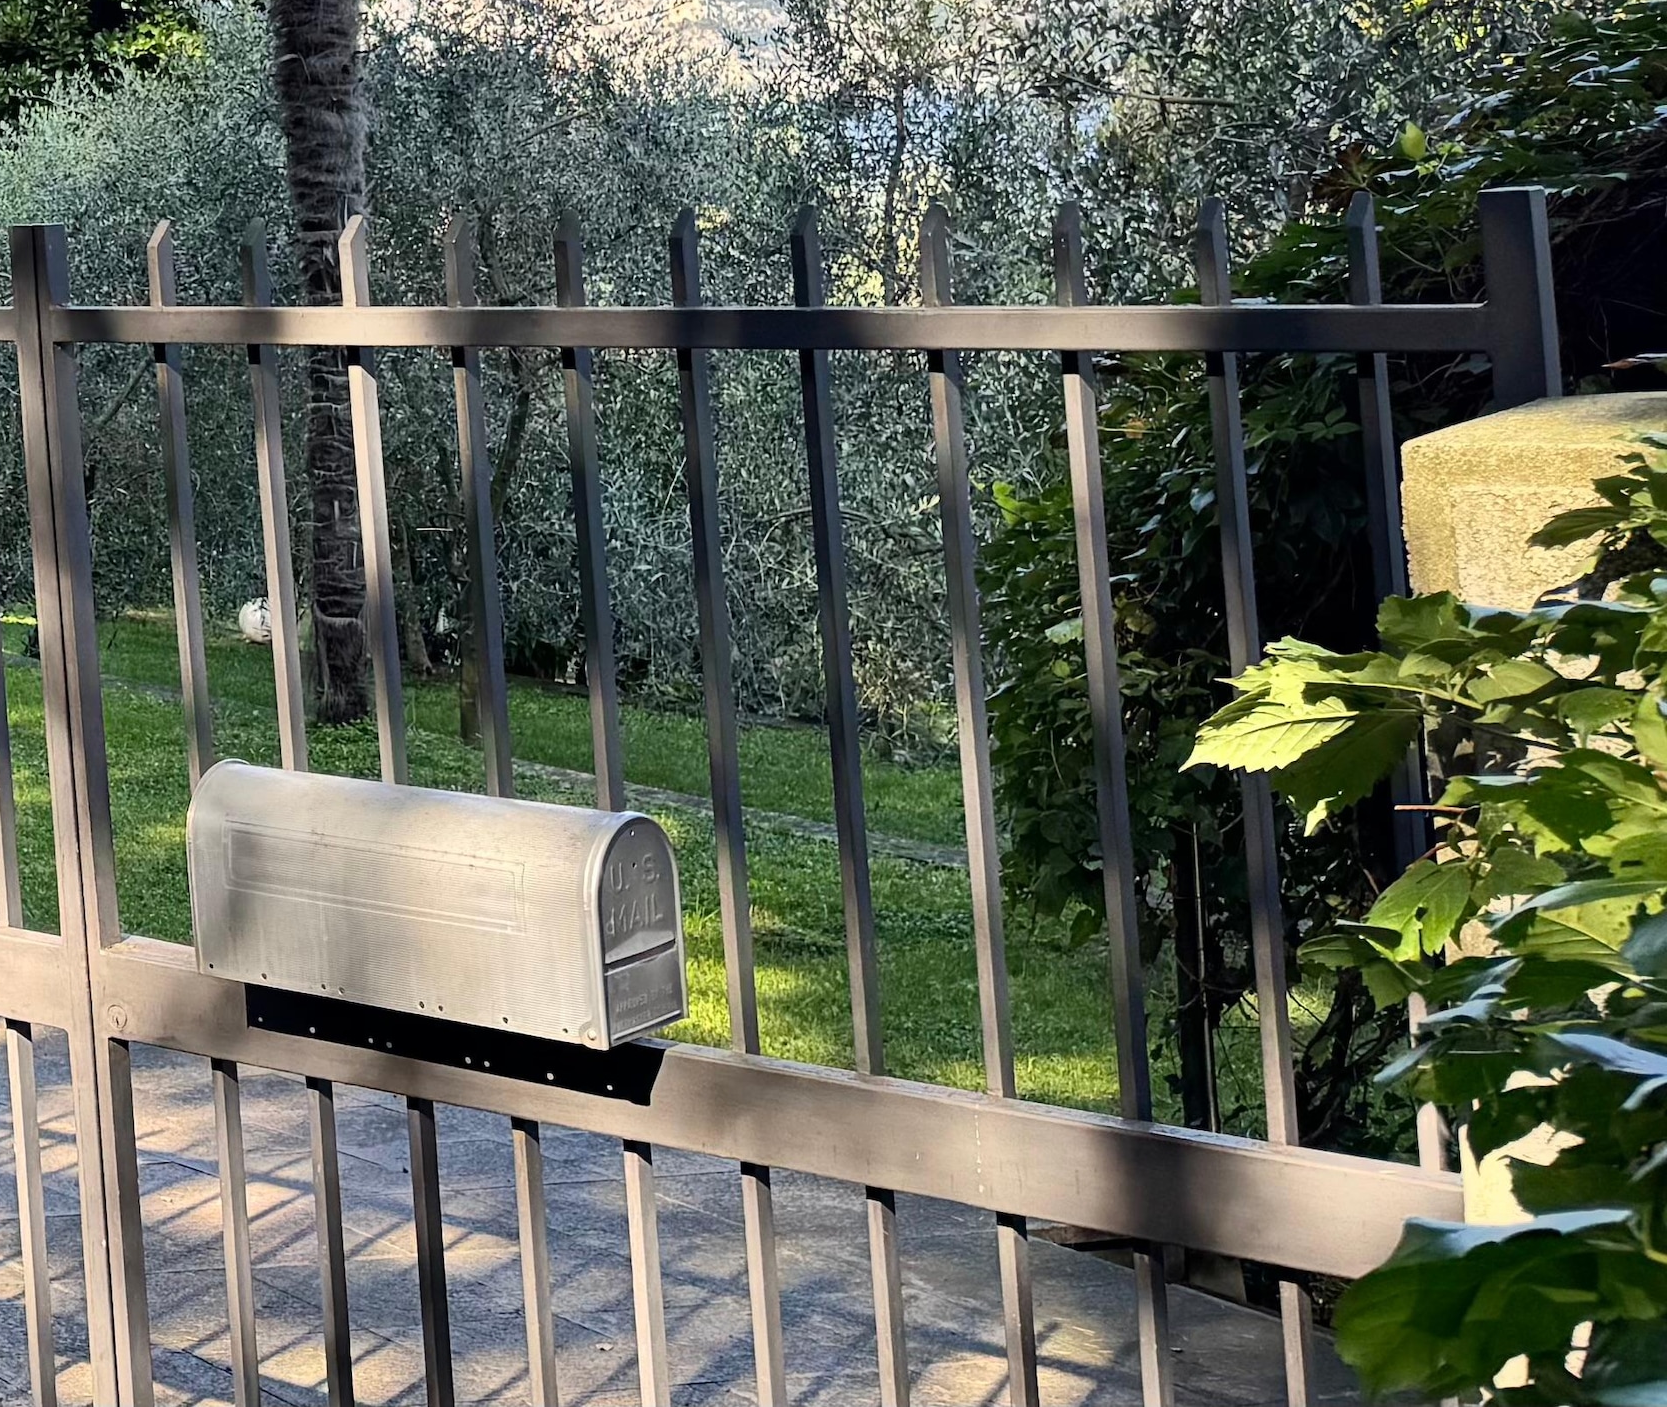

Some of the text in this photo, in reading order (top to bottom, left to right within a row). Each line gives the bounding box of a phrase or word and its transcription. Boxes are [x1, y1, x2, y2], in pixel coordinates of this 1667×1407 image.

[610, 853, 660, 891] U. S.
[606, 893, 664, 936] MAIL
